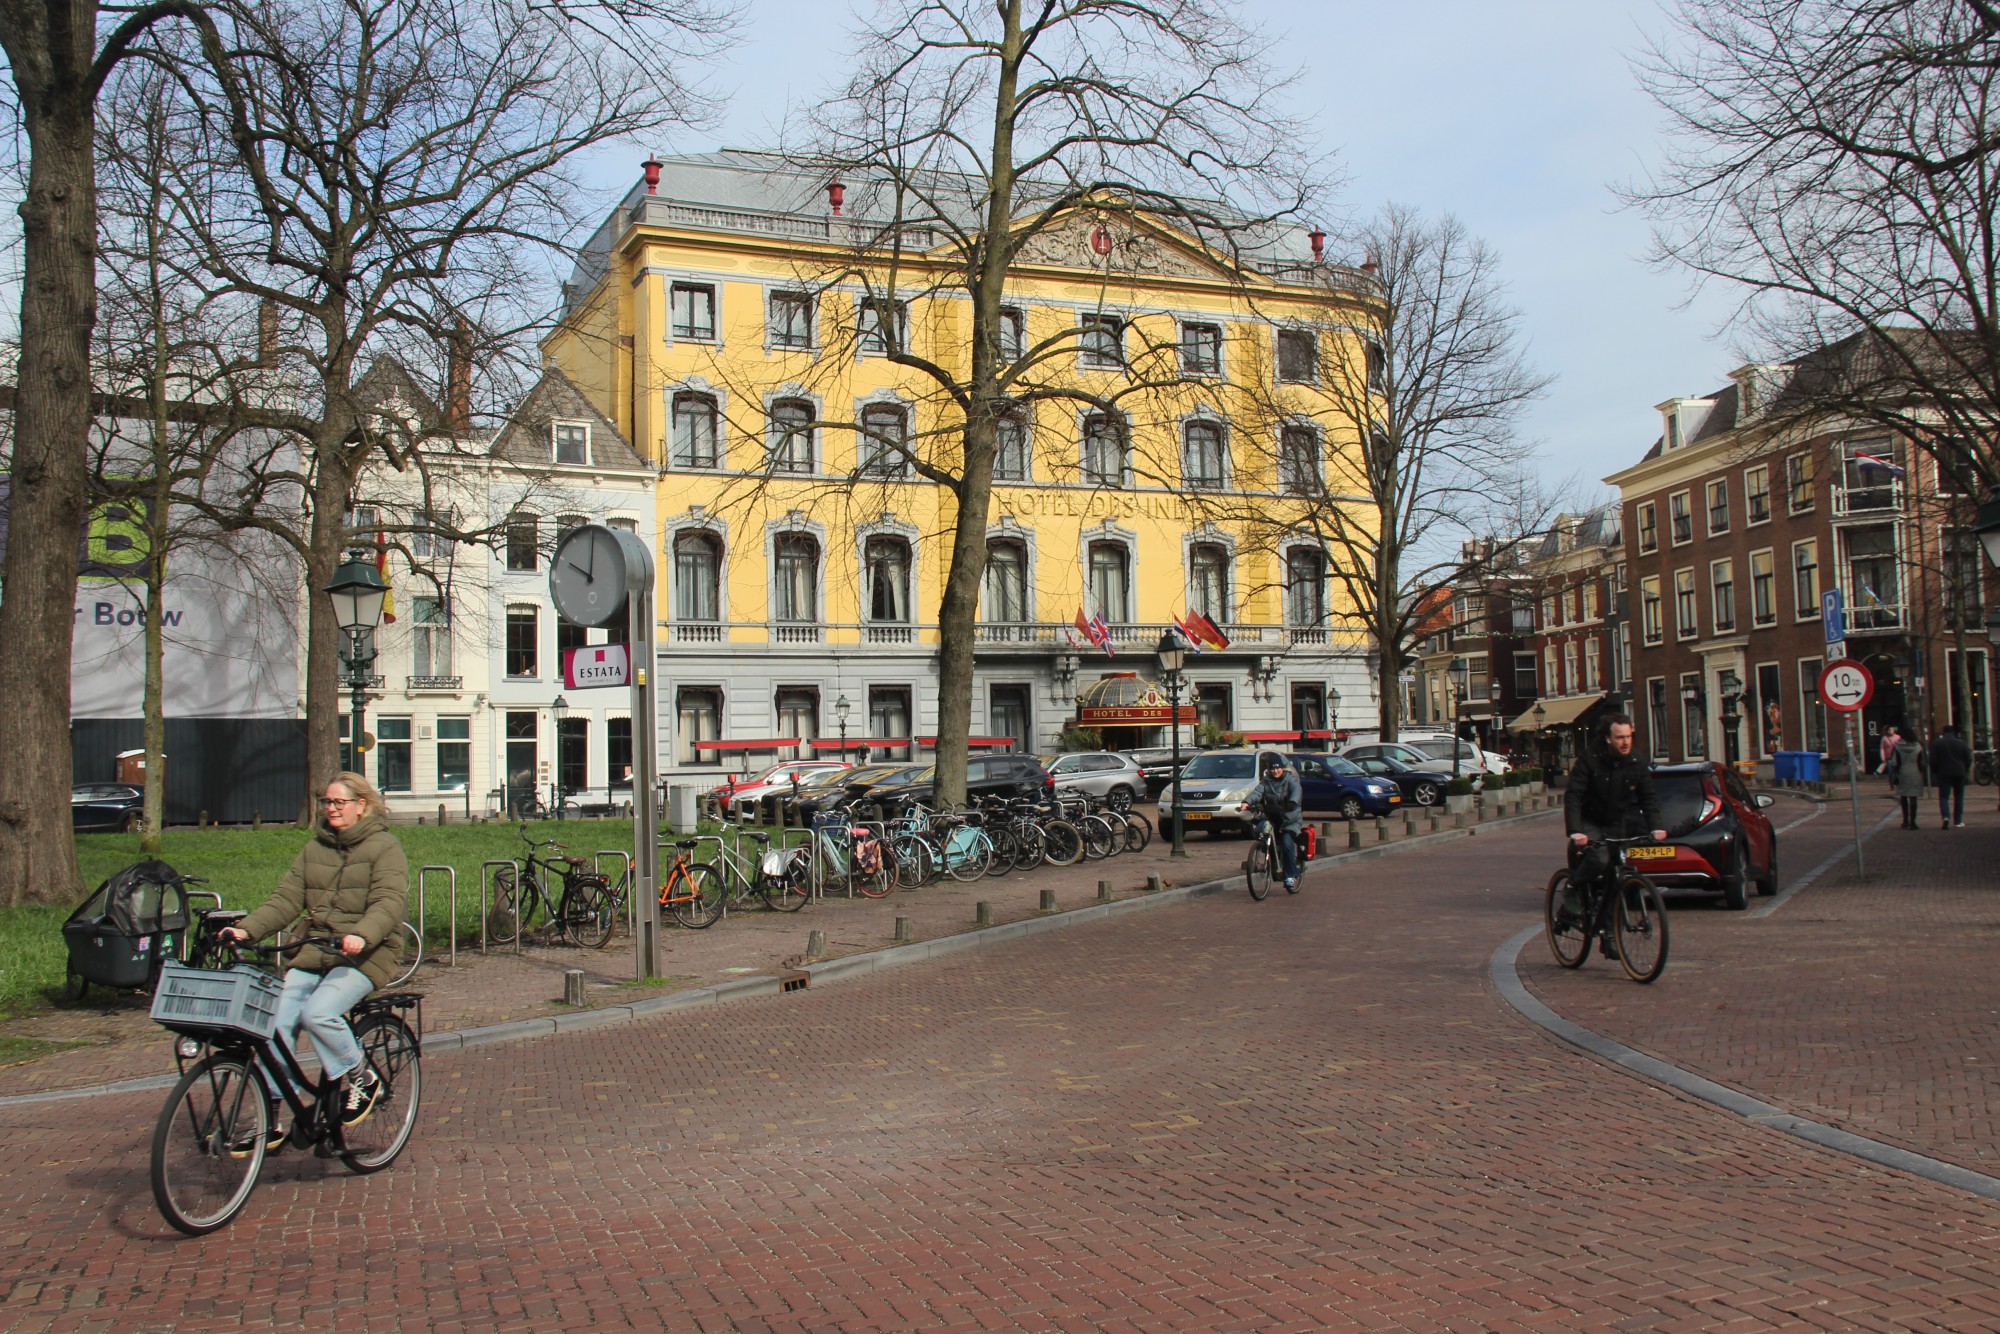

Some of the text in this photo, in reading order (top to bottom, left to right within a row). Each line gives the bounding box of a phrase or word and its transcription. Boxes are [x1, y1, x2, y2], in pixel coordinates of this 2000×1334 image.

[997, 492, 1078, 516] HOTEL
[1091, 495, 1134, 519] DES
[1825, 594, 1836, 621] P
[580, 666, 622, 678] ESTATA
[1833, 673, 1851, 688] 10
